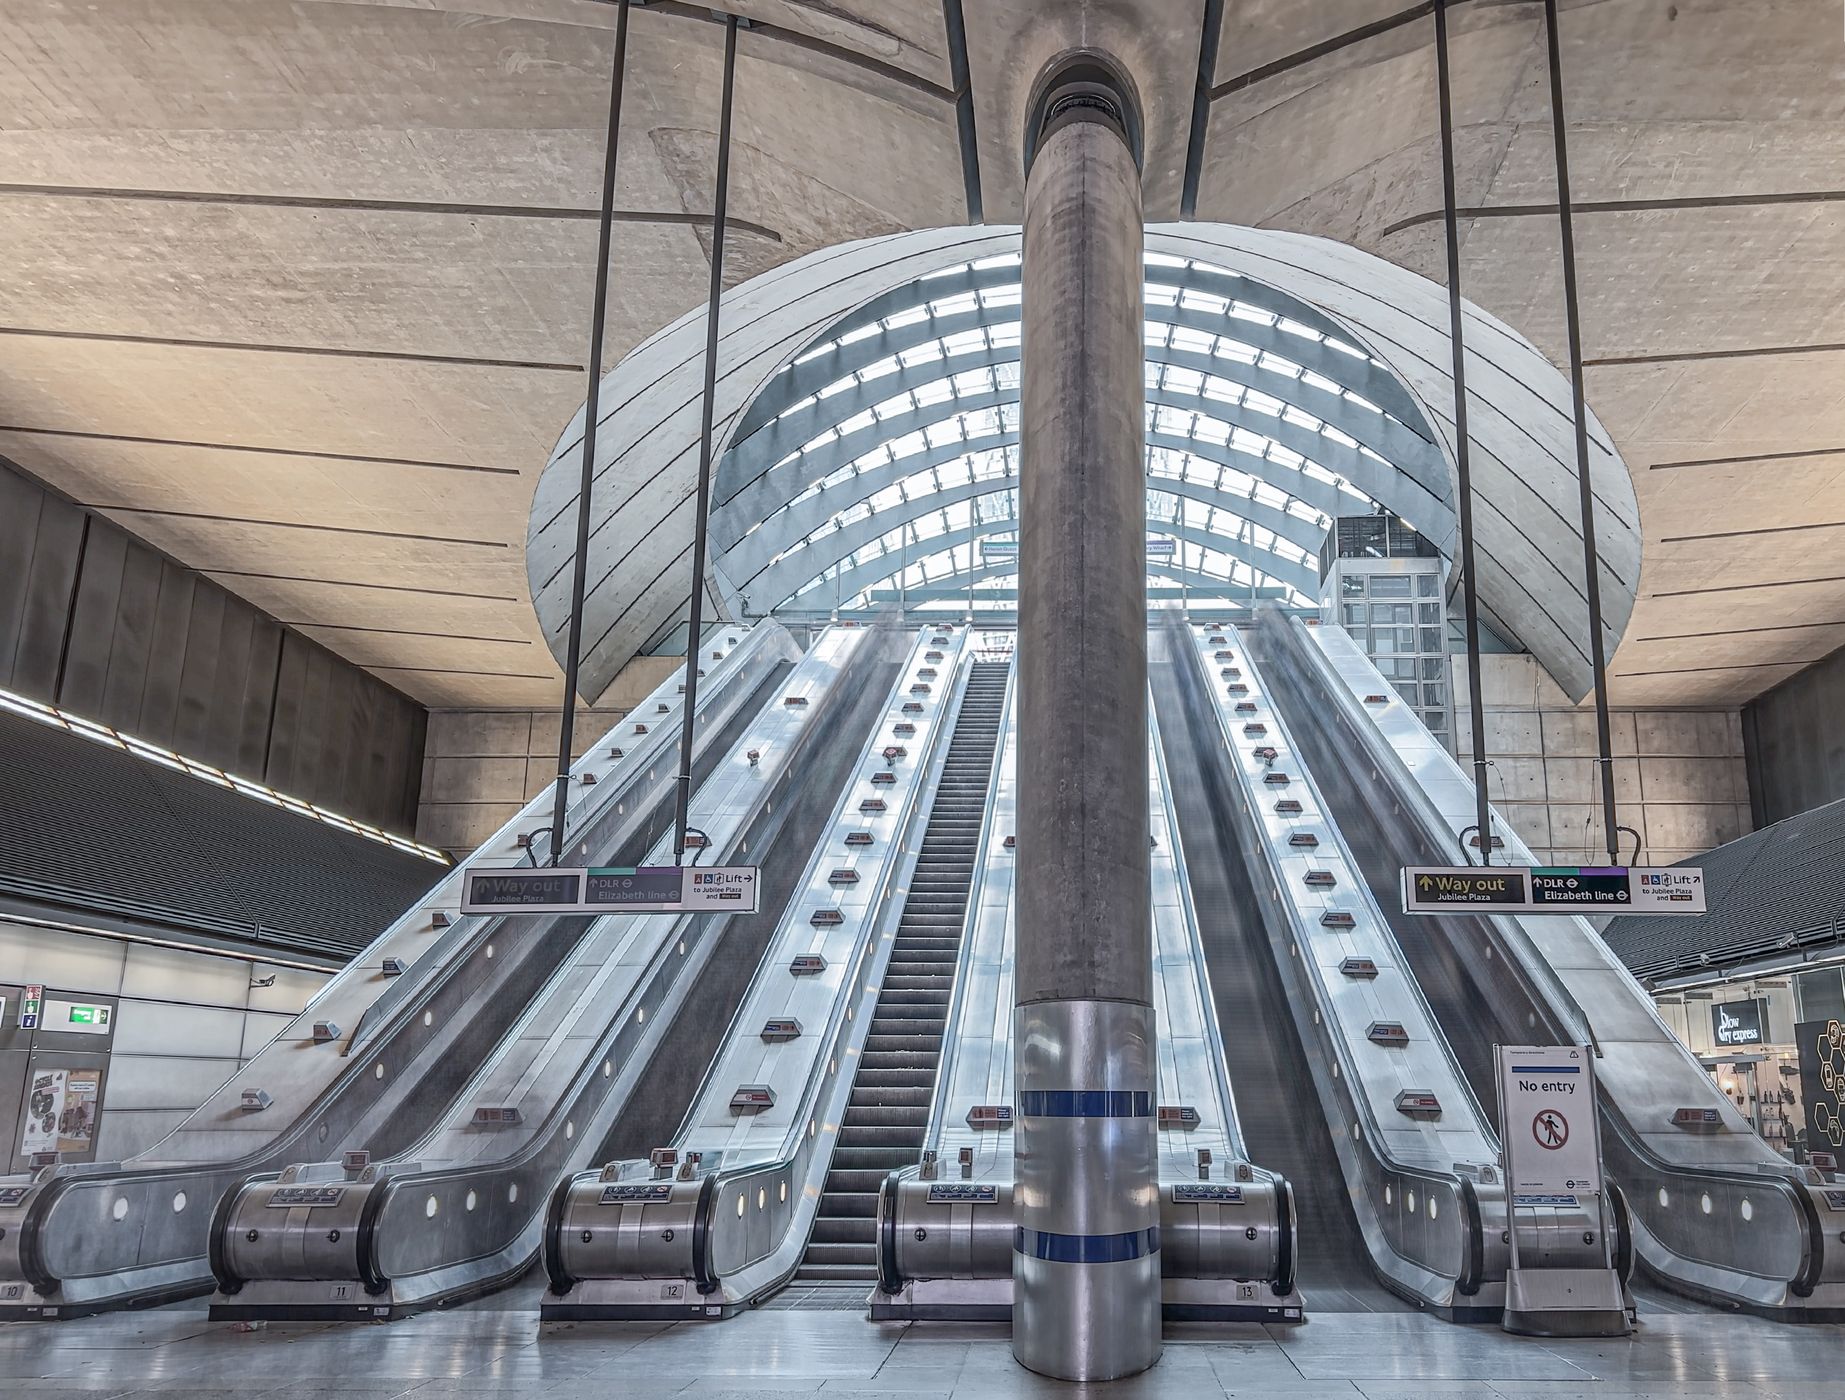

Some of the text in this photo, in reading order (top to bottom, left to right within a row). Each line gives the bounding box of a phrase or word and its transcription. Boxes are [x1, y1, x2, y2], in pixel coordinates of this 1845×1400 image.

[600, 879, 619, 888] DLR
[725, 874, 743, 883] Lift
[1544, 879, 1564, 888] DLR
[1673, 876, 1691, 884] Lift
[493, 879, 561, 895] Way out
[1436, 877, 1505, 893] Way out
[491, 895, 521, 903] Jubilee
[598, 889, 666, 900] Elizabeth line
[1437, 893, 1490, 902] Jubilee Plaza
[1544, 890, 1614, 900] Elizabeth line
[1732, 1029, 1757, 1043] express
[1519, 1080, 1575, 1094] No entry
[7, 1286, 18, 1296] 10
[336, 1286, 346, 1297] 11
[667, 1285, 678, 1296] 12
[1242, 1286, 1253, 1297] 13
